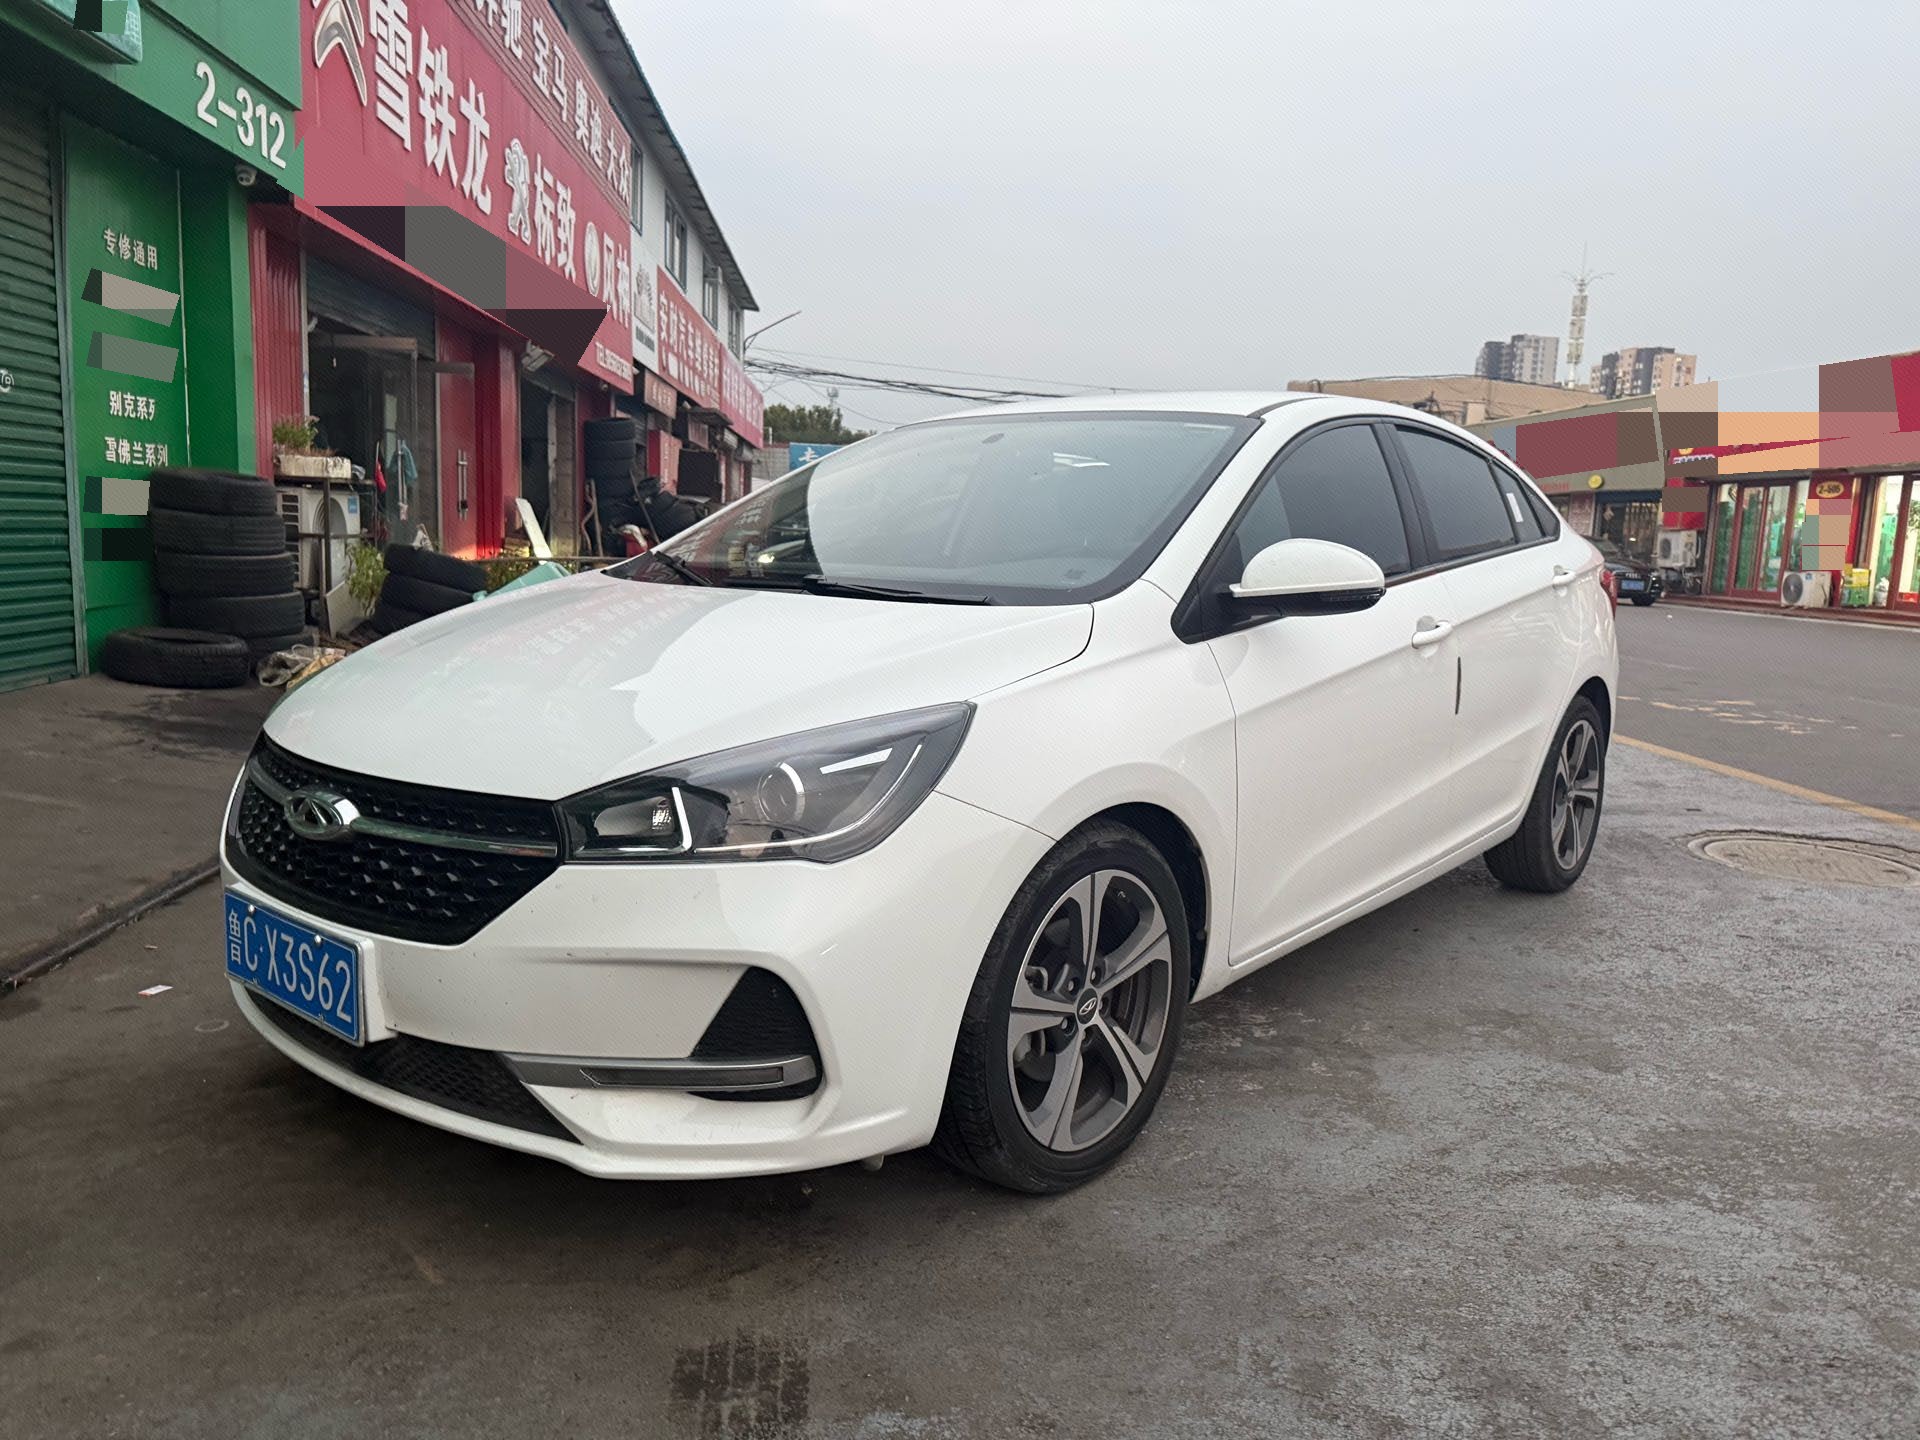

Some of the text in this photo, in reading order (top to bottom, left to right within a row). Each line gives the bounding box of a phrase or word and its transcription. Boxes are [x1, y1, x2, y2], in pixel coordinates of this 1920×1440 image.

[196, 61, 287, 169] 2-312
[370, 0, 491, 216] 雪铁龙
[534, 153, 577, 284] 标致
[532, 17, 568, 123] 宝马
[574, 78, 602, 169] 奥迪
[606, 127, 631, 208] 大众
[103, 227, 158, 271] 专修通用
[104, 435, 169, 468] 雪佛兰系列
